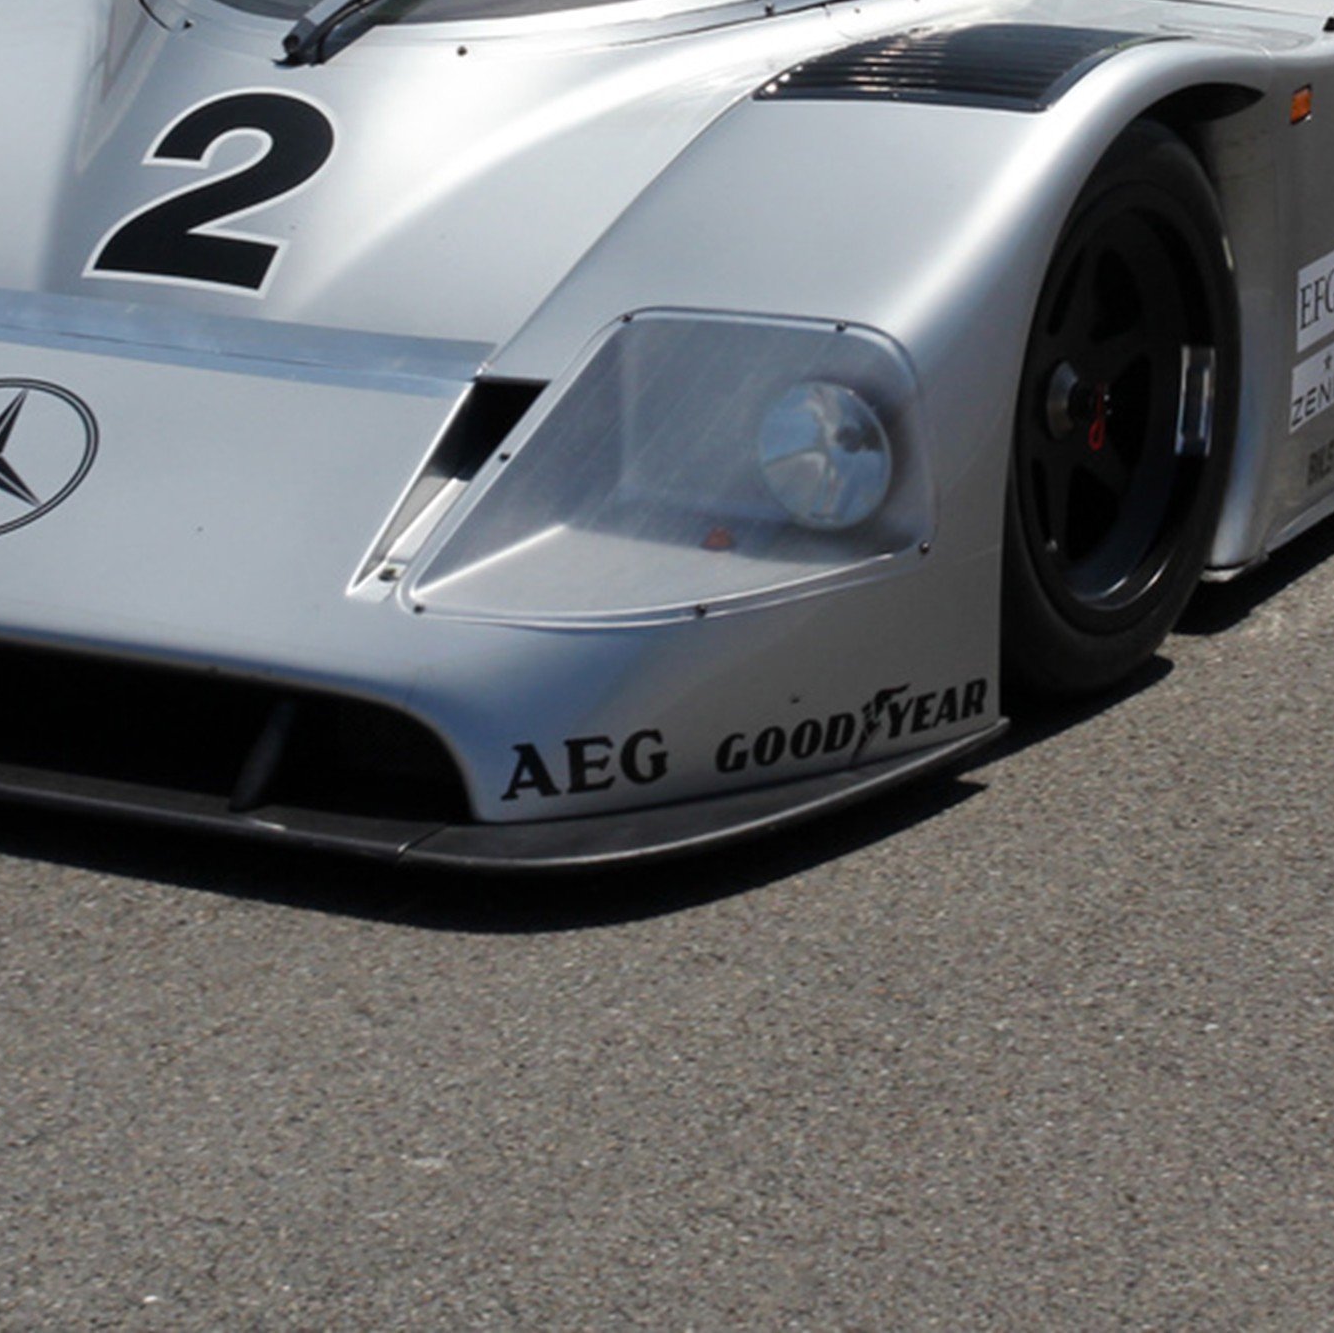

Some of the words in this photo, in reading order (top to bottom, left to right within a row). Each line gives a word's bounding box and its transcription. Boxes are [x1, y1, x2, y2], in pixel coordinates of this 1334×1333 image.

[94, 91, 334, 290] 2
[501, 728, 669, 801] AEG
[715, 677, 988, 774] GOODYEAR
